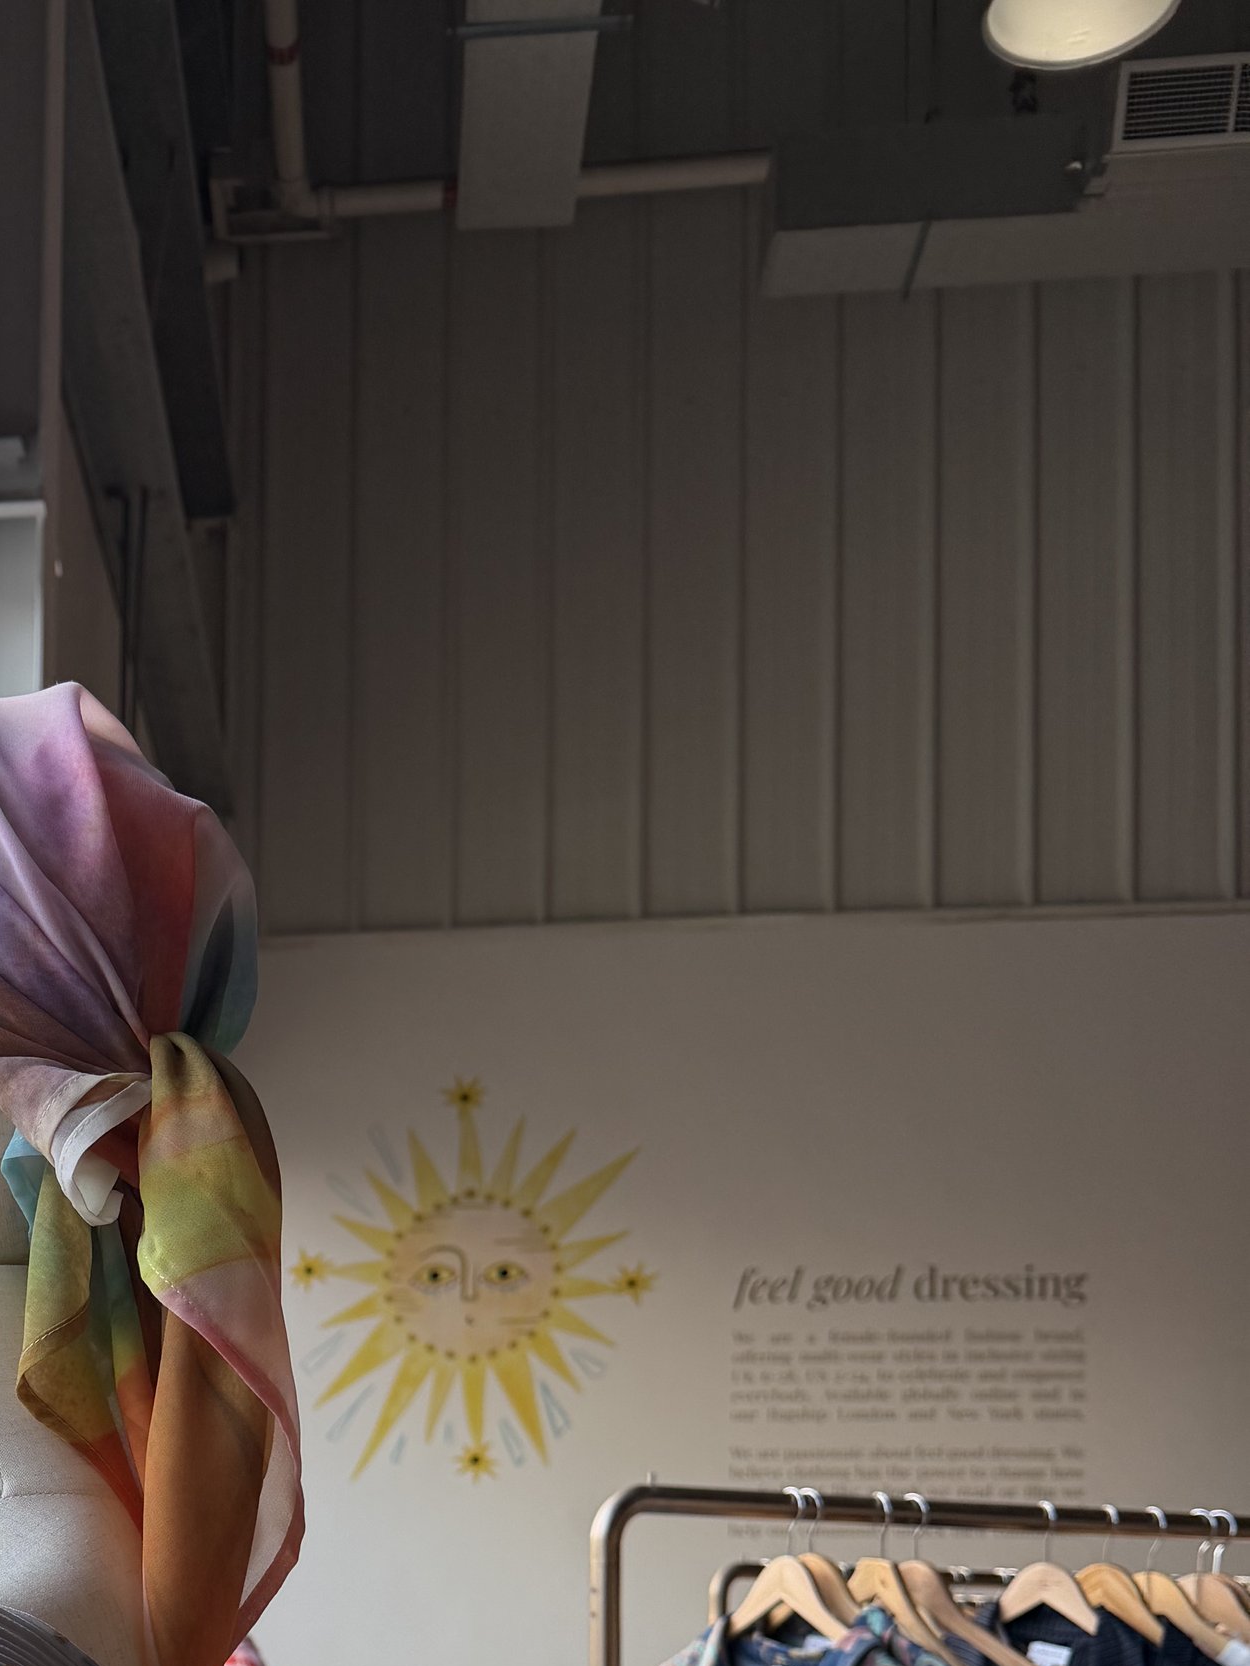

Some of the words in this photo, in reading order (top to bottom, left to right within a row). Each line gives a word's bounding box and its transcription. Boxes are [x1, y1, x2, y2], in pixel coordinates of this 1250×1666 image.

[732, 1263, 804, 1312] feel
[805, 1263, 904, 1313] good
[912, 1263, 1089, 1309] dressing
